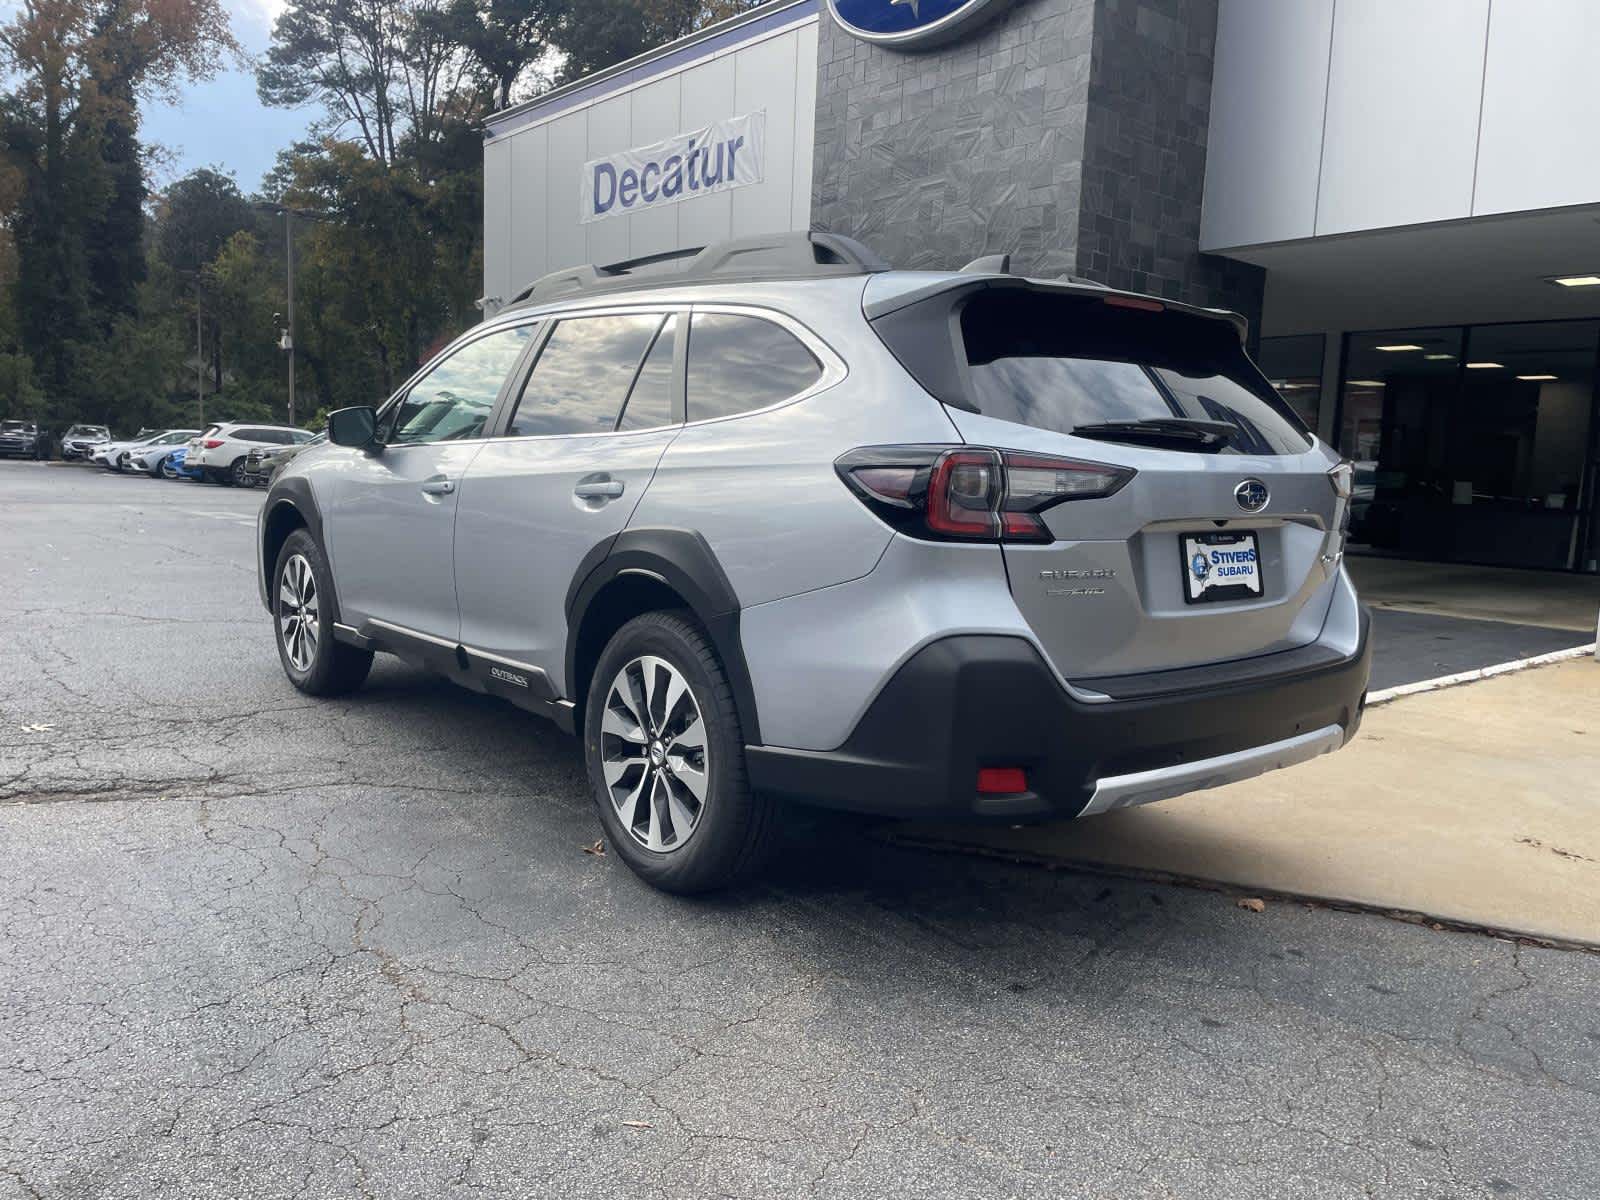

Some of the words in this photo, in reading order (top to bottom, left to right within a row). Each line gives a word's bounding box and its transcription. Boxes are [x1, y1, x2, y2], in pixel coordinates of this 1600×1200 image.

[593, 135, 744, 215] Decatur
[1211, 548, 1256, 564] STIVERS
[1217, 566, 1253, 577] SUBARU
[491, 667, 528, 685] OUTBACK
